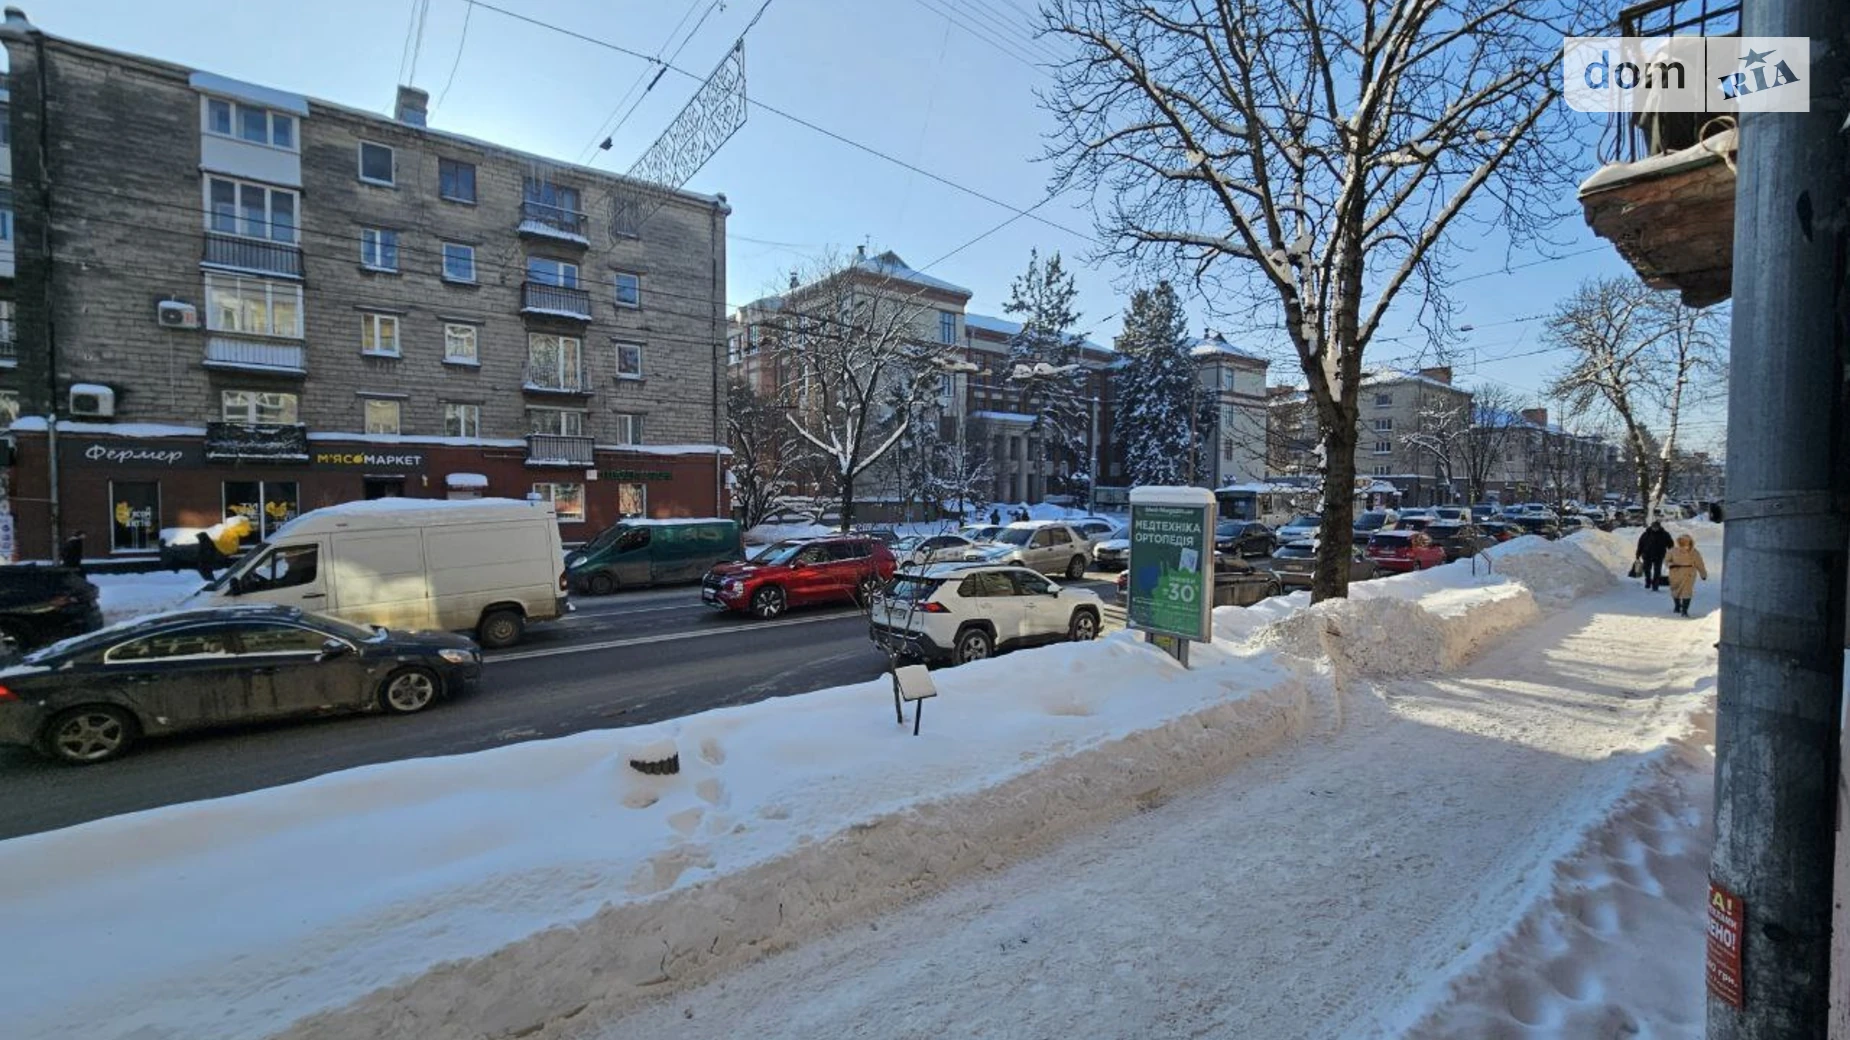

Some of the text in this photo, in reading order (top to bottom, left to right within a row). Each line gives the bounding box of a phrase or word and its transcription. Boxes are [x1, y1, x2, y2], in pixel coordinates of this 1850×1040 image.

[84, 444, 184, 465] Фермер
[1135, 519, 1201, 533] МЕДТЕХНІКА
[1135, 532, 1195, 547] ОРТОПЕДІЯ
